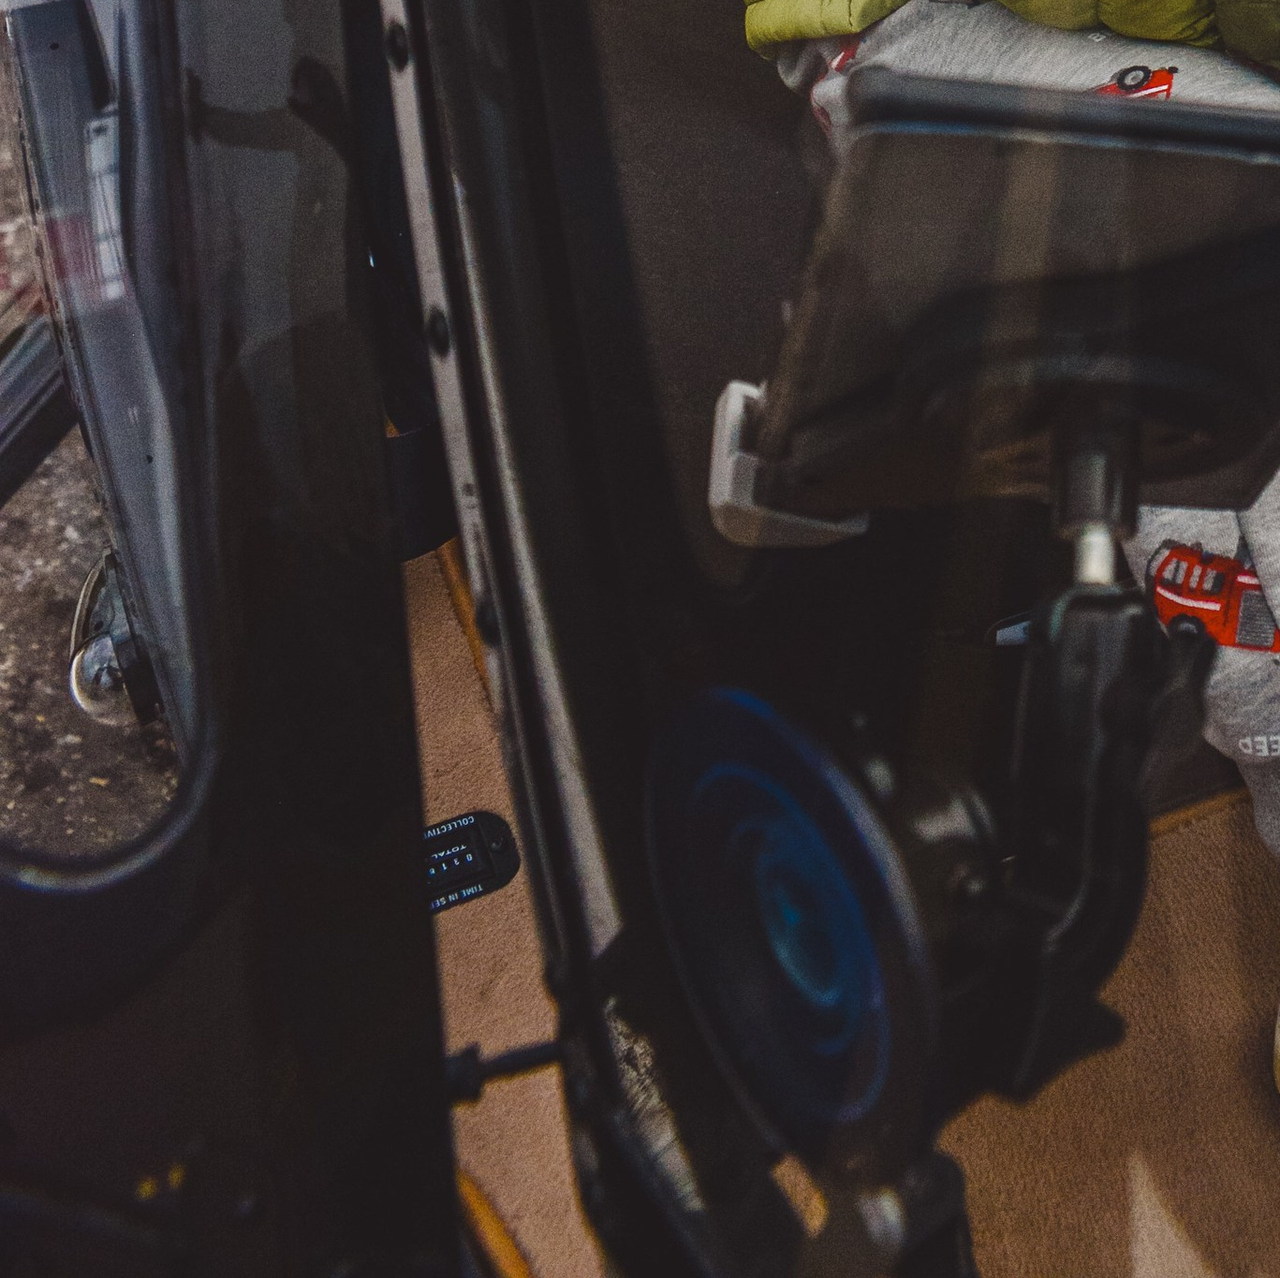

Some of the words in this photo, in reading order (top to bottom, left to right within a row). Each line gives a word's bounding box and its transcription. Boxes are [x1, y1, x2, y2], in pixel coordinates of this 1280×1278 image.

[431, 845, 467, 859] TOTAL
[448, 892, 458, 902] IN
[461, 884, 483, 898] TIME
